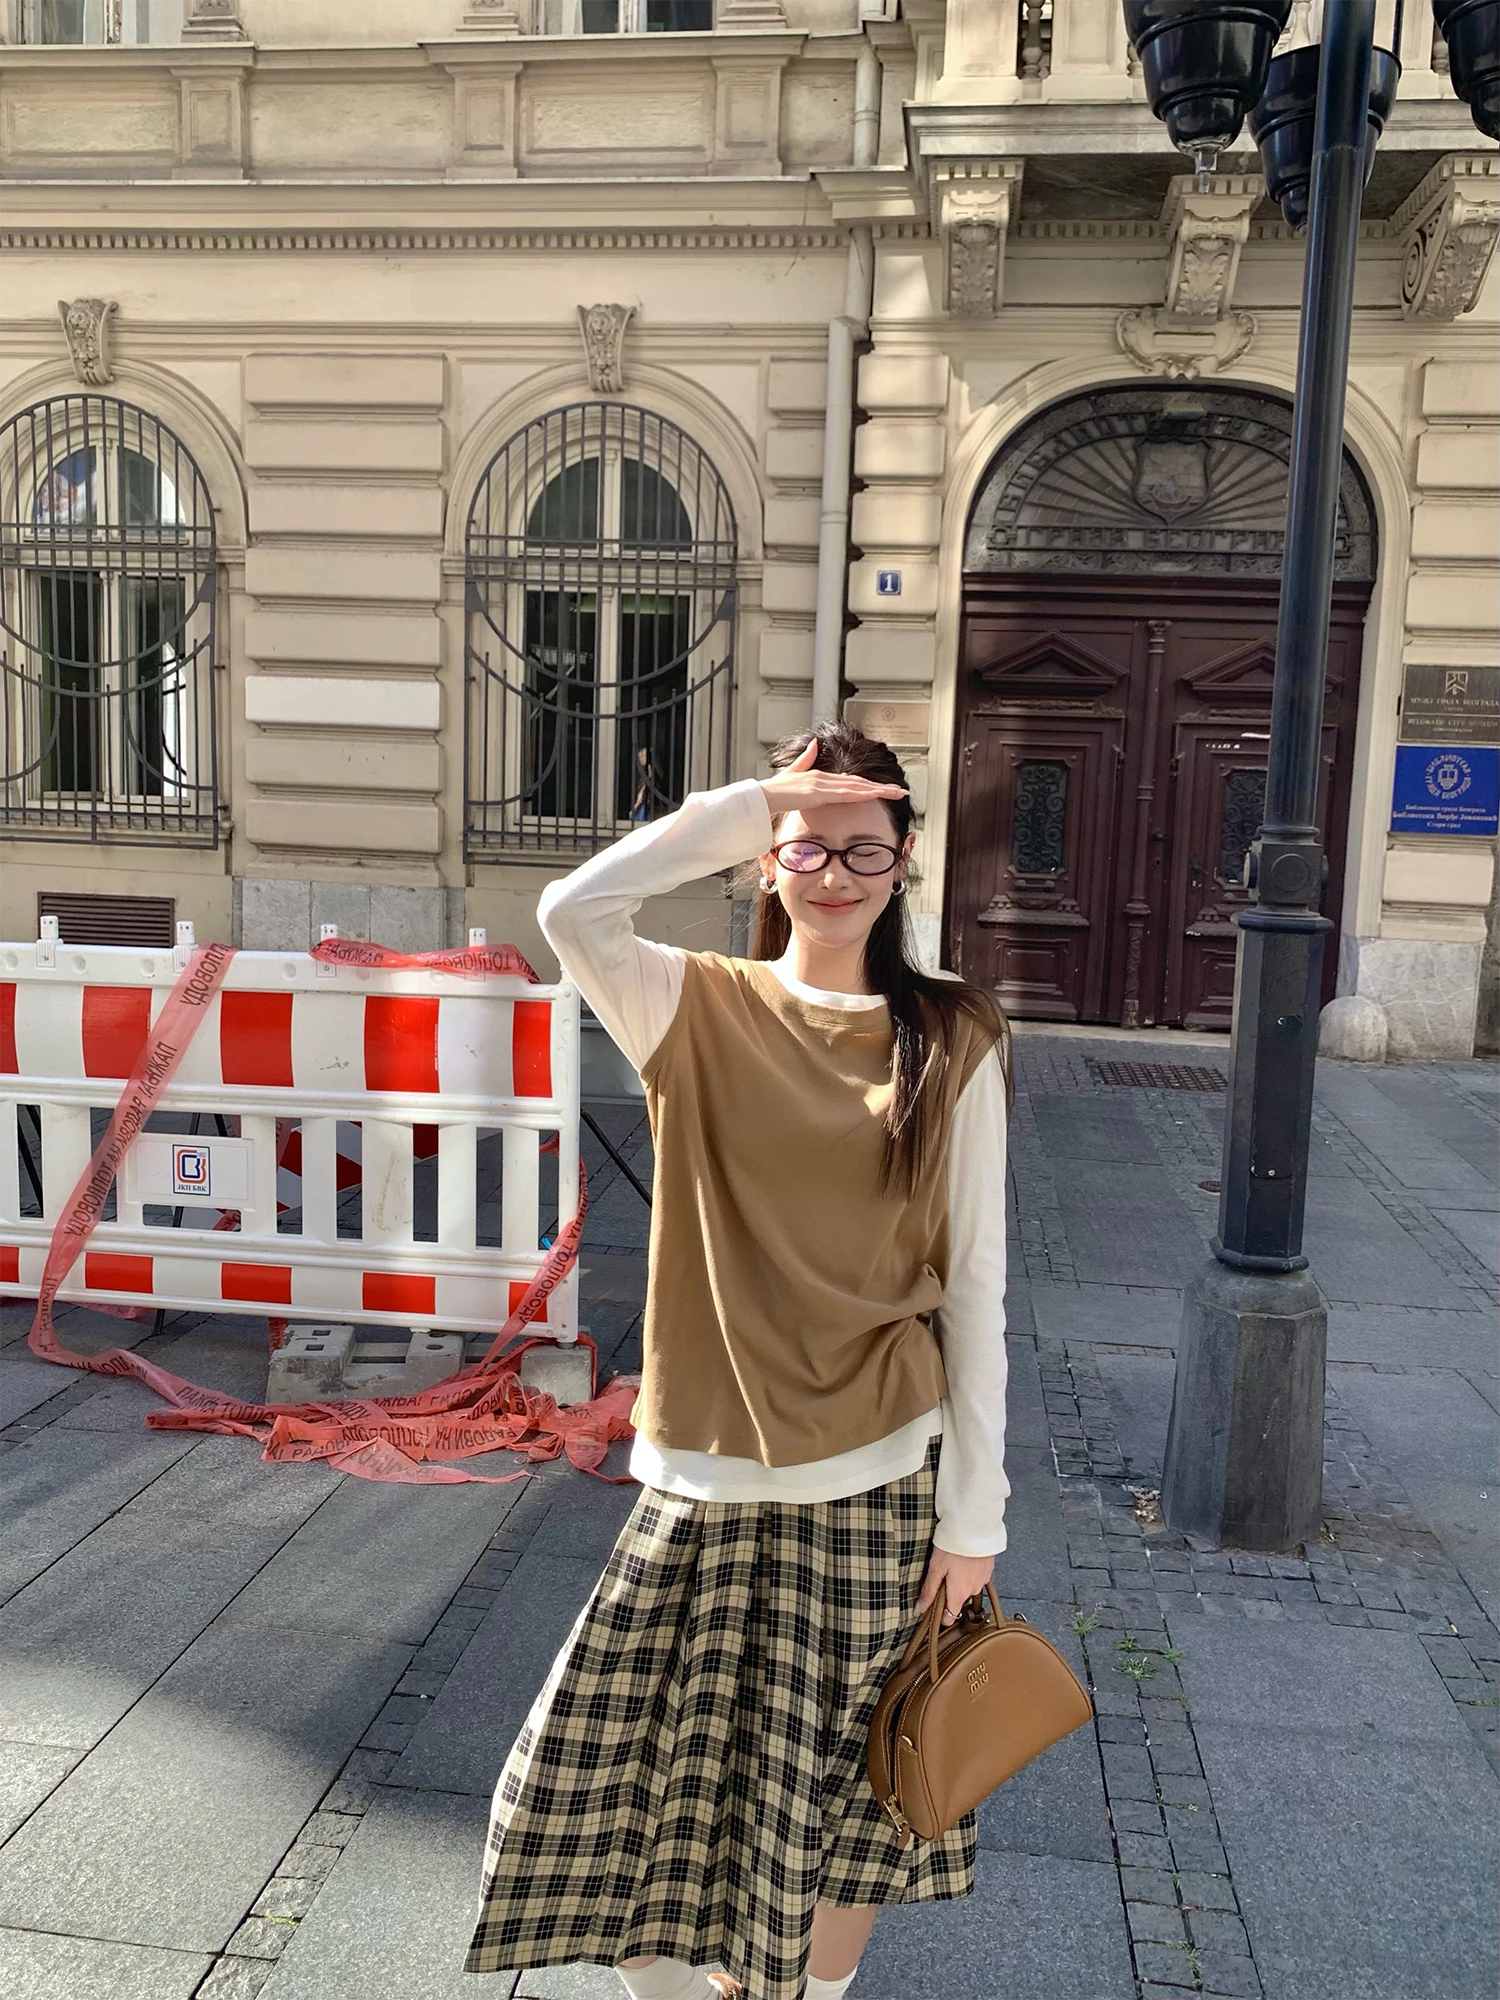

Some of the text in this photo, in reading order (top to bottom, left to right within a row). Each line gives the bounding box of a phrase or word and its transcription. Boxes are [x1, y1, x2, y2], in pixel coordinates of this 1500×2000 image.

[885, 574, 894, 591] 1
[1407, 717, 1445, 726] BELGRADE
[1447, 719, 1466, 727] CITY
[518, 1244, 574, 1325] ТОПЛОВОДУ
[376, 1396, 423, 1408] АЖЊА!
[435, 1426, 452, 1450] НА
